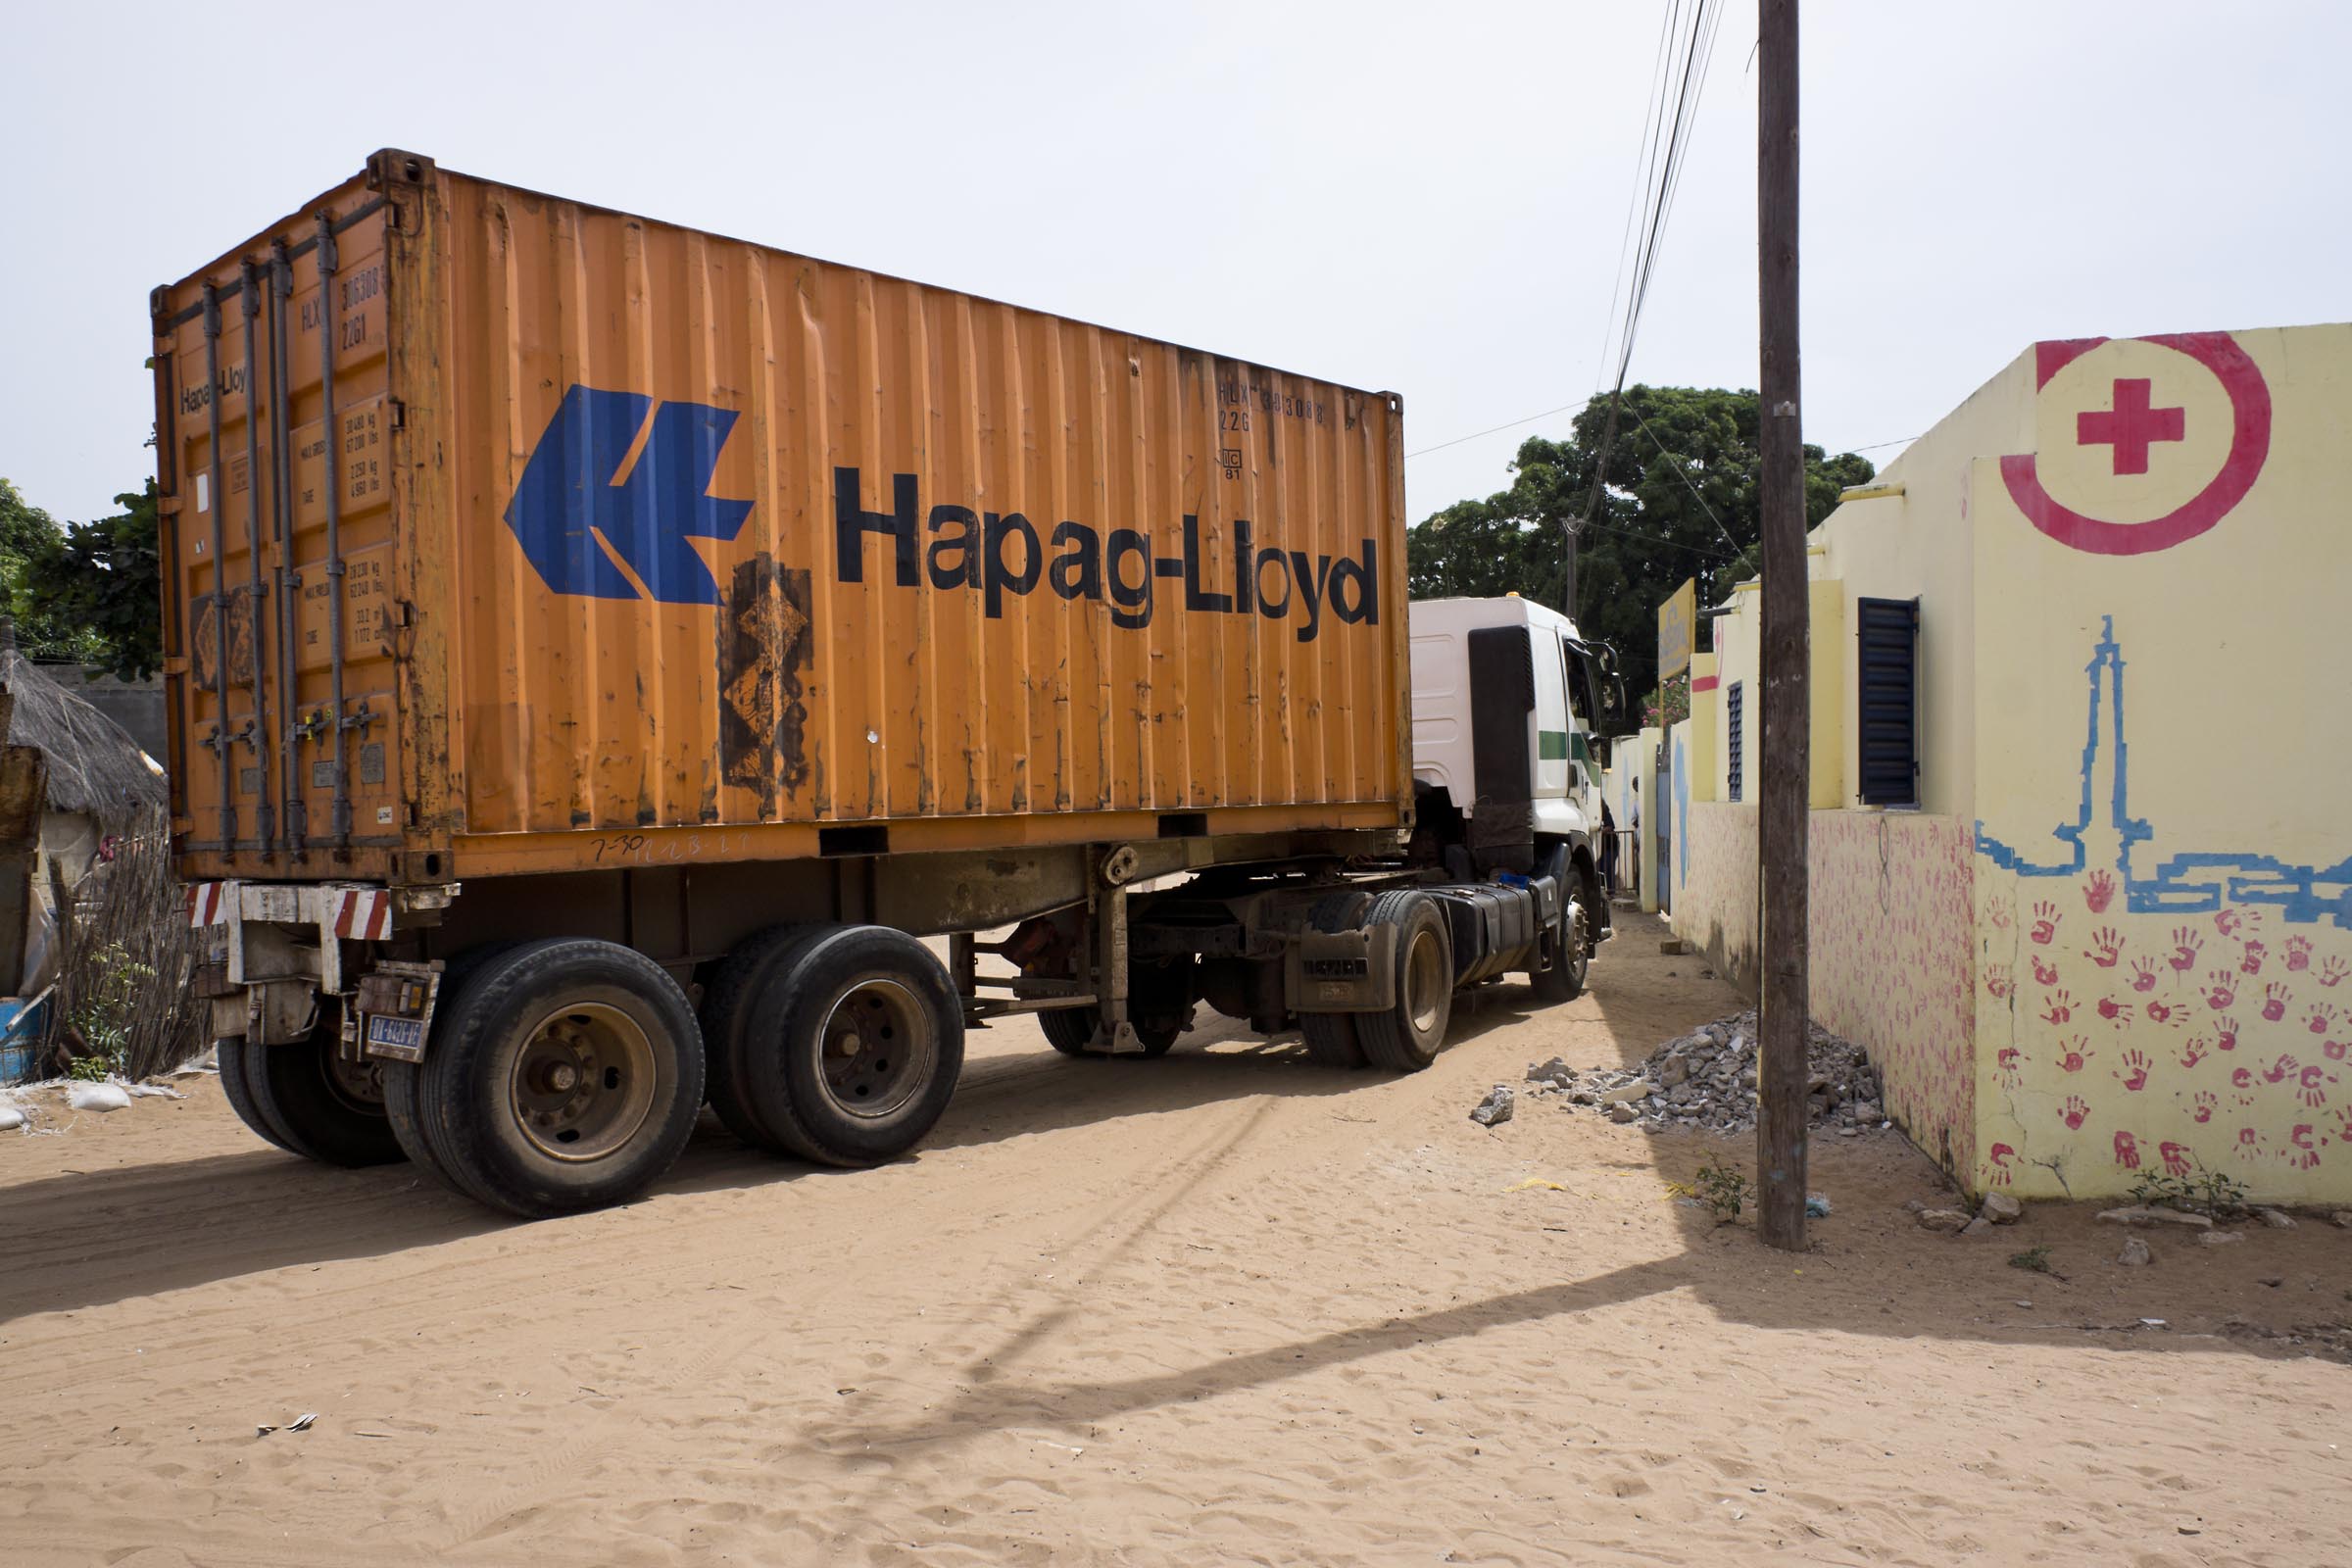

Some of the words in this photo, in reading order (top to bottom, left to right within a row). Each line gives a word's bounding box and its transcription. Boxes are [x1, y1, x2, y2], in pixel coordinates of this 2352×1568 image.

[301, 297, 320, 334] HLX
[342, 312, 367, 351] 22G1
[1219, 383, 1249, 404] HLX
[1220, 410, 1250, 432] 22G
[1225, 469, 1240, 480] 81
[834, 466, 1380, 643] Hapag-Lloyd
